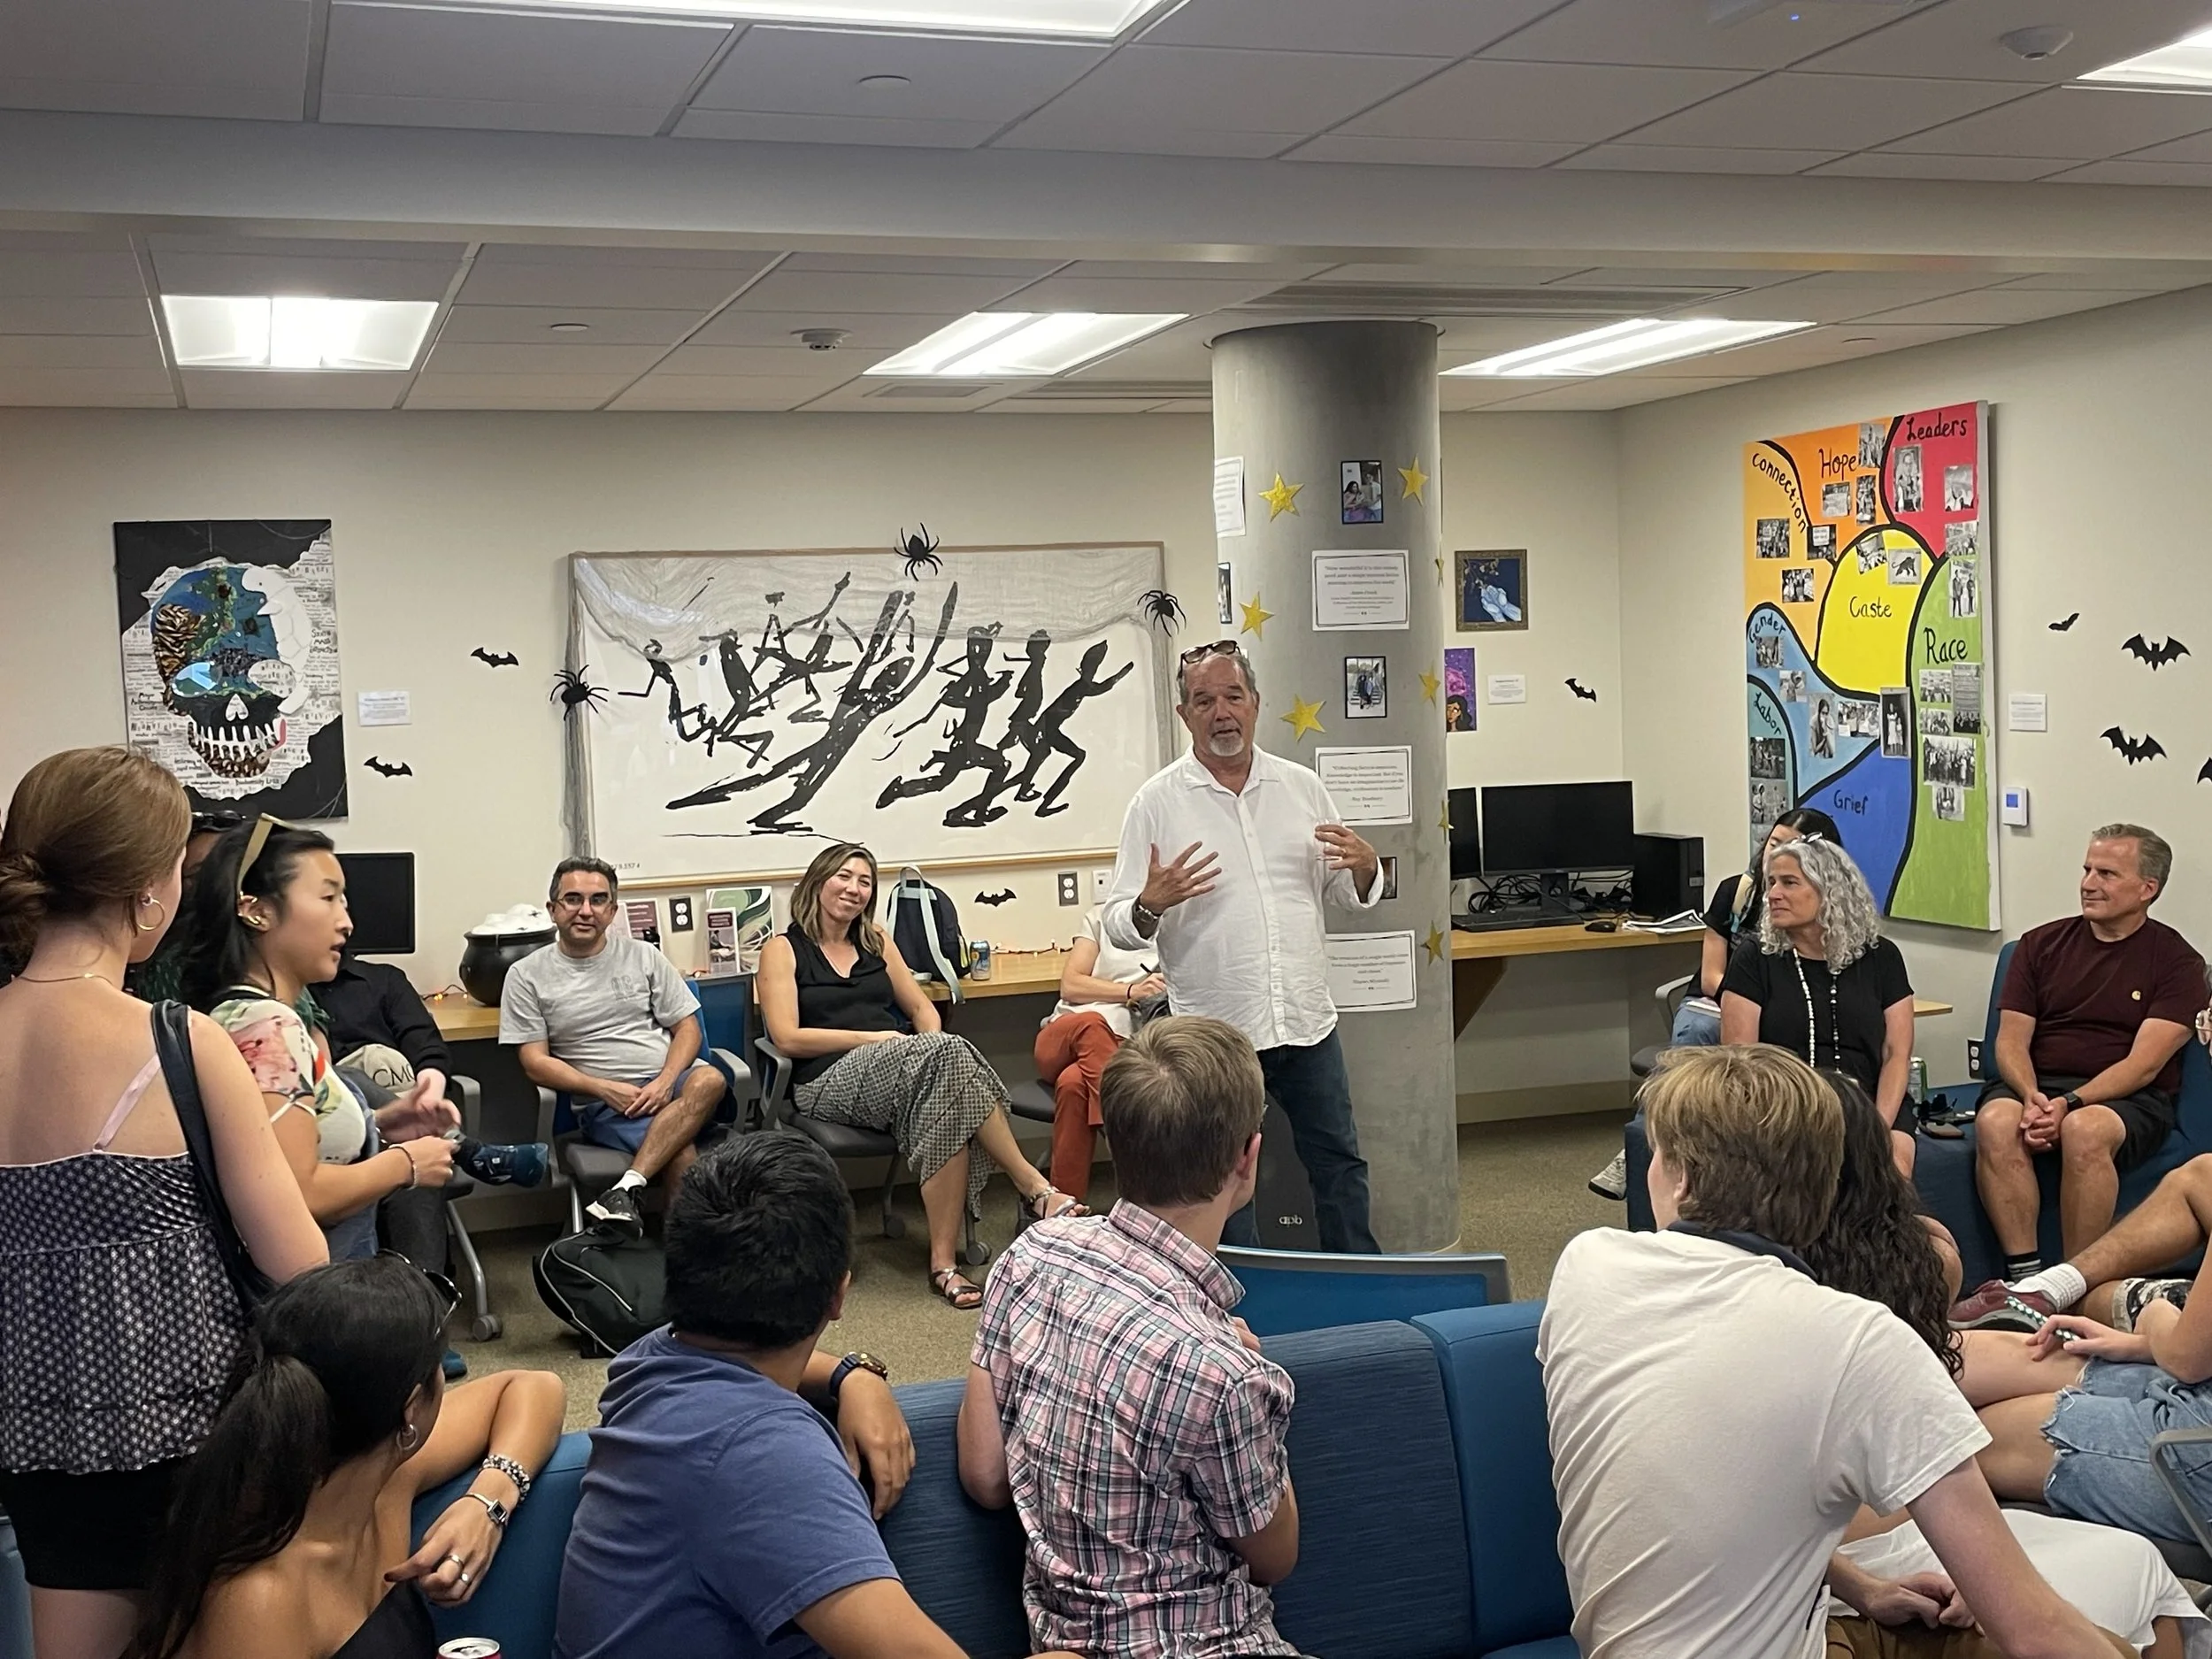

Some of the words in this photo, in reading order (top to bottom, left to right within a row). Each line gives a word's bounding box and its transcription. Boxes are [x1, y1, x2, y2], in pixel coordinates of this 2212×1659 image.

[1907, 411, 1967, 442] Leaders
[1818, 448, 1857, 481] Hope
[1849, 596, 1892, 618] Caste
[1748, 611, 1786, 643] Gender
[1923, 627, 1969, 664] Race
[1754, 691, 1782, 736] Labor
[1833, 789, 1869, 816] Grief
